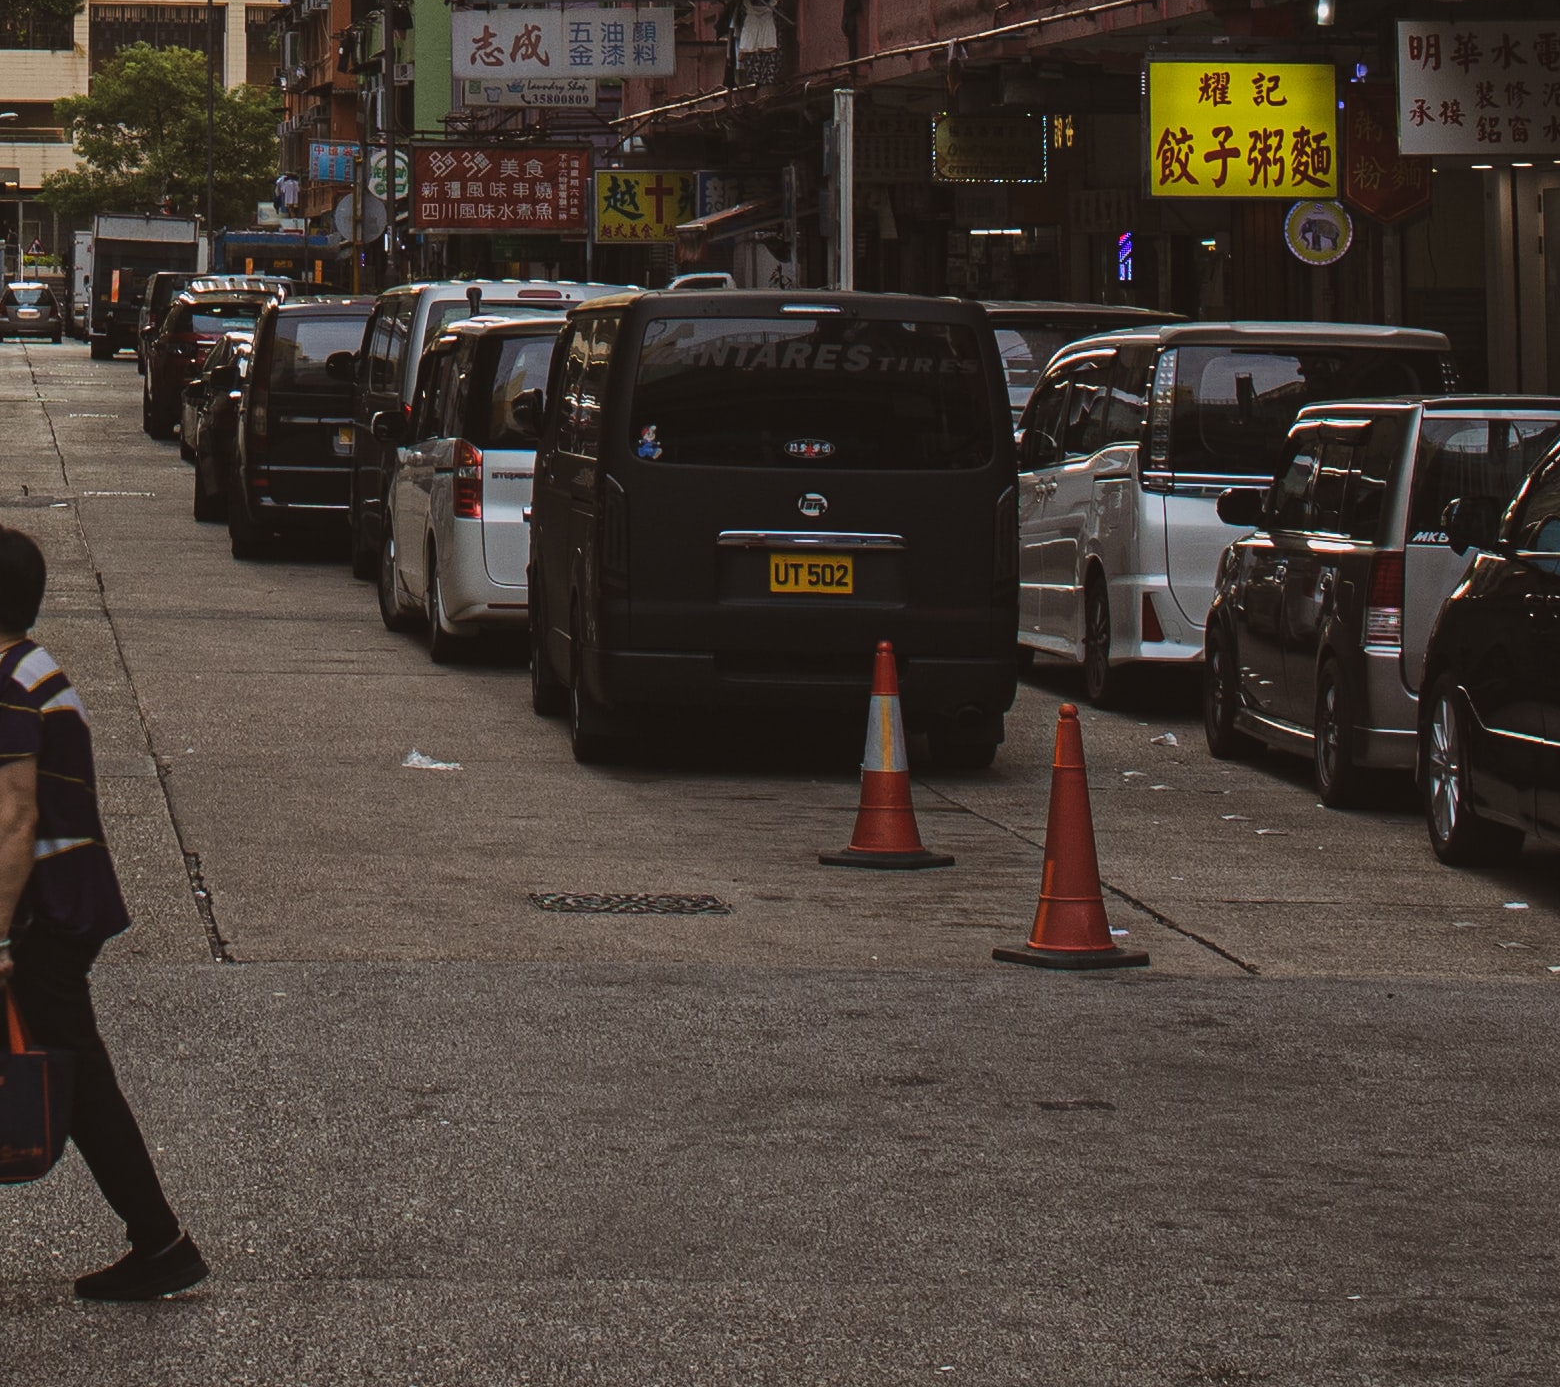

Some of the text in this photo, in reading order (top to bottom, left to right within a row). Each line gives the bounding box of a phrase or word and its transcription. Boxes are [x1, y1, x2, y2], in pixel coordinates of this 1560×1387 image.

[527, 78, 587, 95] Laundry Shop
[532, 93, 589, 105] 35800809
[1198, 71, 1288, 108] 耀記
[1409, 98, 1466, 128] 承接
[1156, 125, 1331, 189] 餃子粥麵
[1353, 155, 1423, 191] 粉麵
[422, 203, 553, 221] 四川風味水煮魚
[880, 356, 979, 375] TIRES
[774, 563, 850, 588] UT 502
